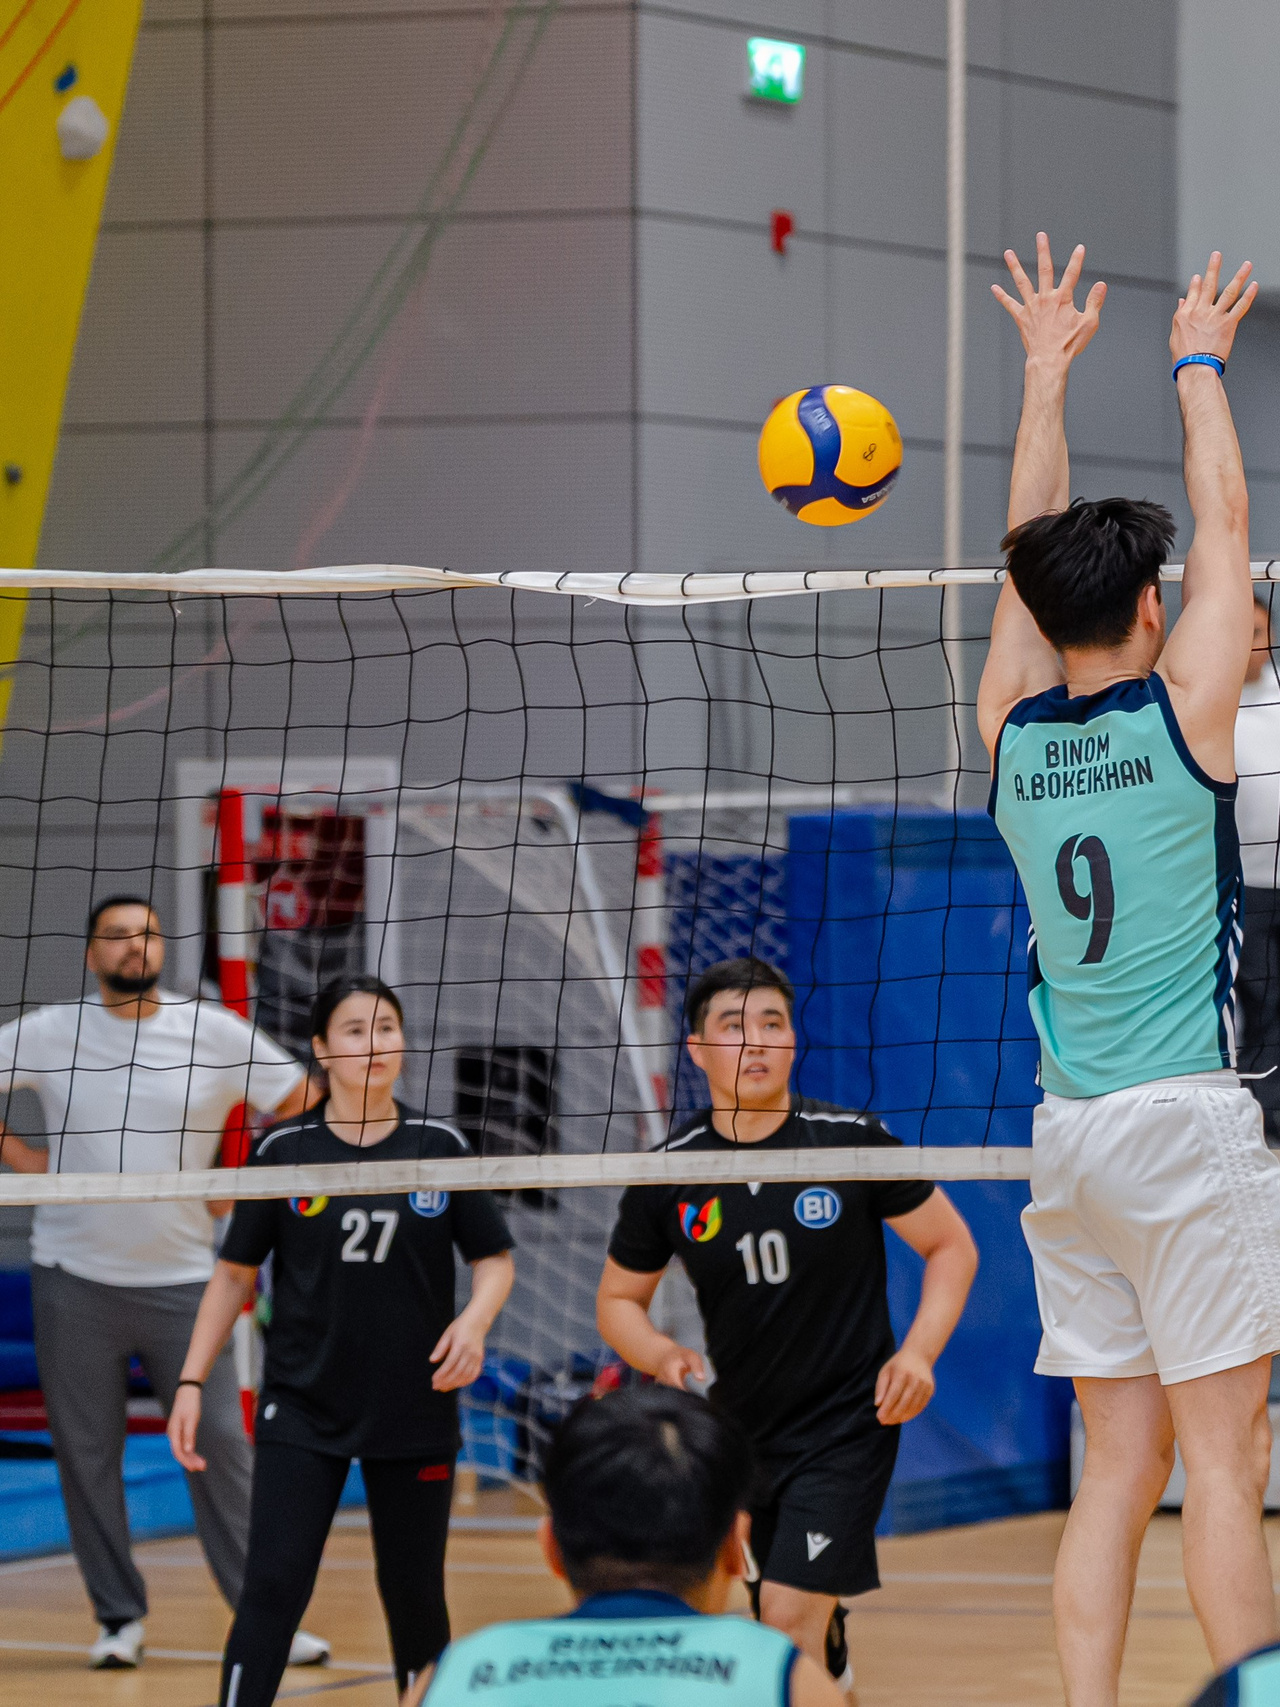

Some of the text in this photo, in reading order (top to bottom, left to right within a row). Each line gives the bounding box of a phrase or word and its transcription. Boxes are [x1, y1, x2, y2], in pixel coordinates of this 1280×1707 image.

[1045, 732, 1110, 769] BINOM
[1014, 755, 1154, 801] A.BOKEIKHAN
[1055, 833, 1115, 966] 9
[803, 1194, 833, 1221] BI
[341, 1208, 400, 1264] 27
[735, 1229, 790, 1285] 10
